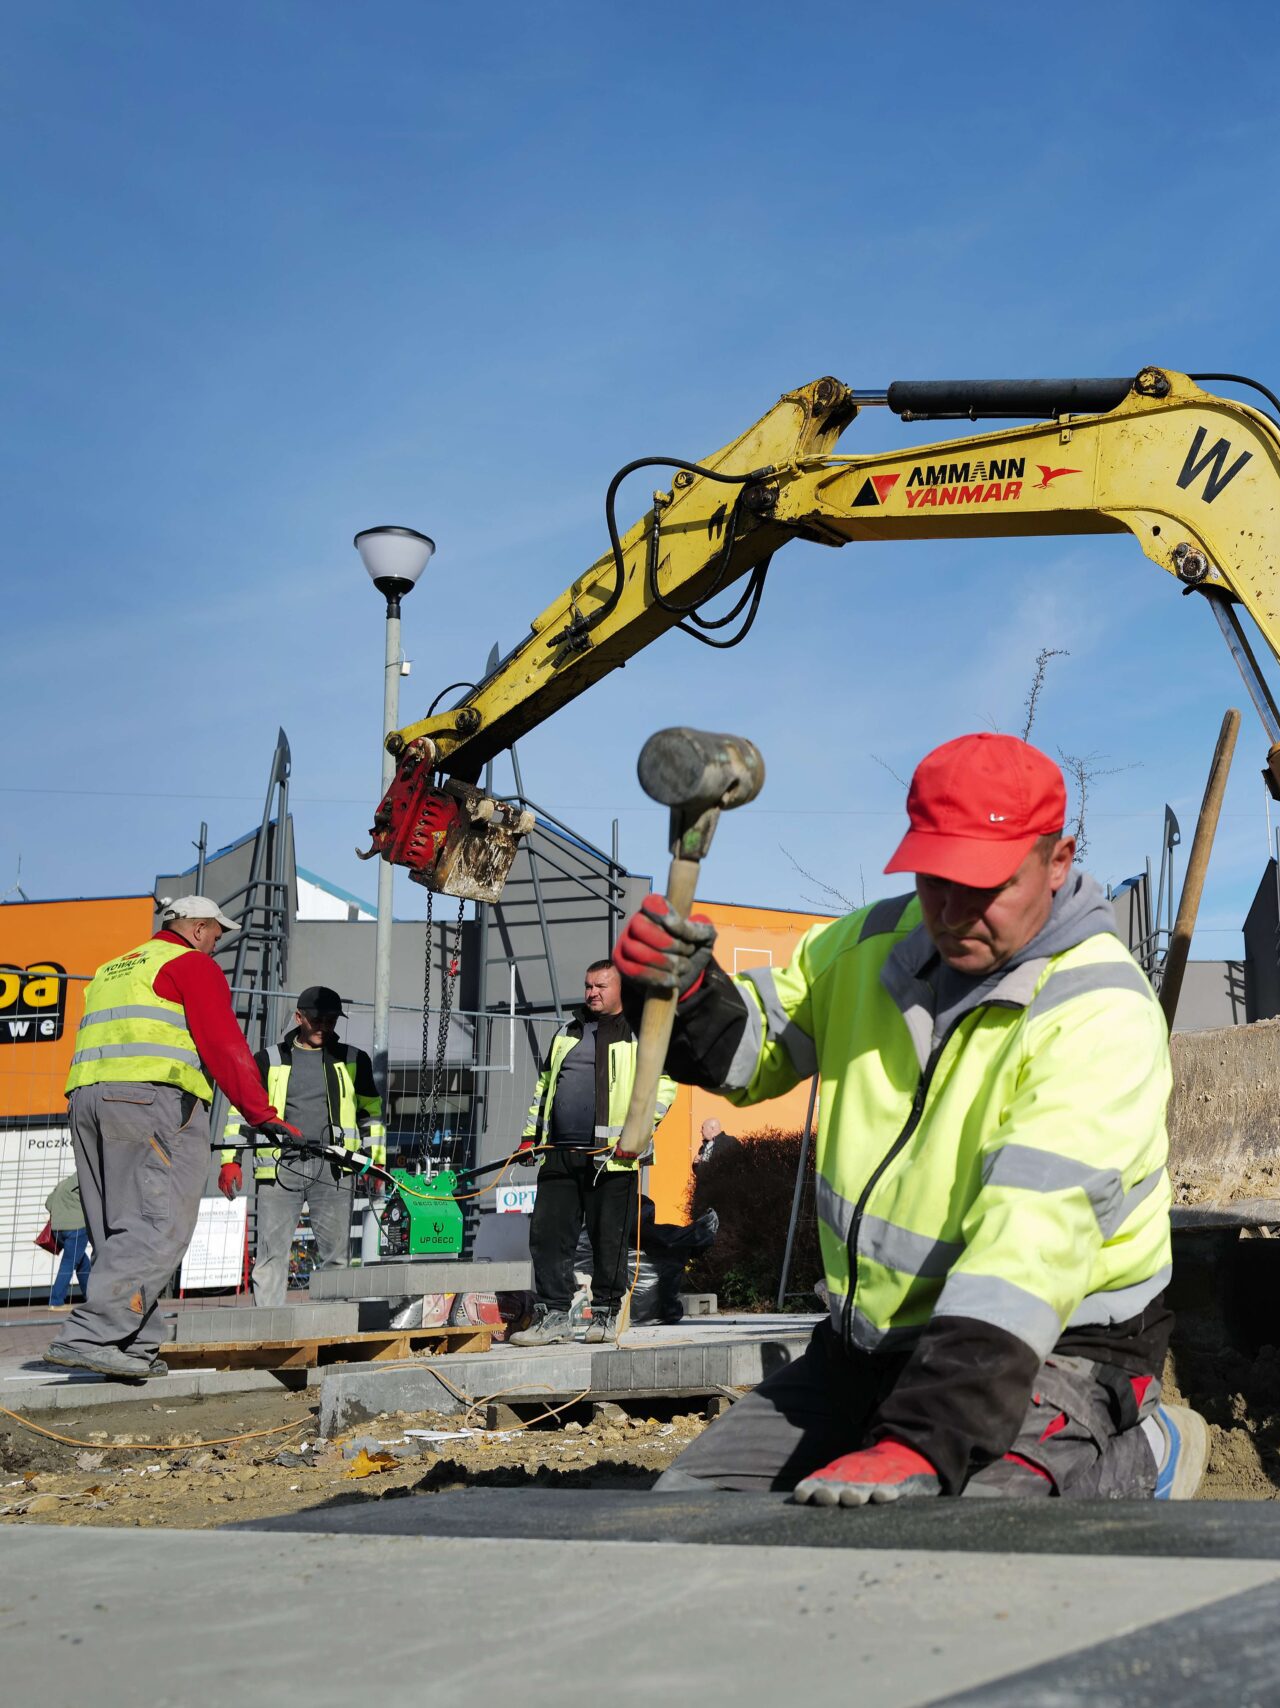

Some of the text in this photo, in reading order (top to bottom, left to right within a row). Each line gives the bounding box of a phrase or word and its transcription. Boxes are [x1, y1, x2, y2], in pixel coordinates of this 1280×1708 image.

[905, 457, 1026, 487] AMMANN
[1176, 425, 1253, 505] W
[904, 481, 1024, 508] YANMAR
[503, 1190, 537, 1207] OPT
[420, 1236, 454, 1244] UP GECO
